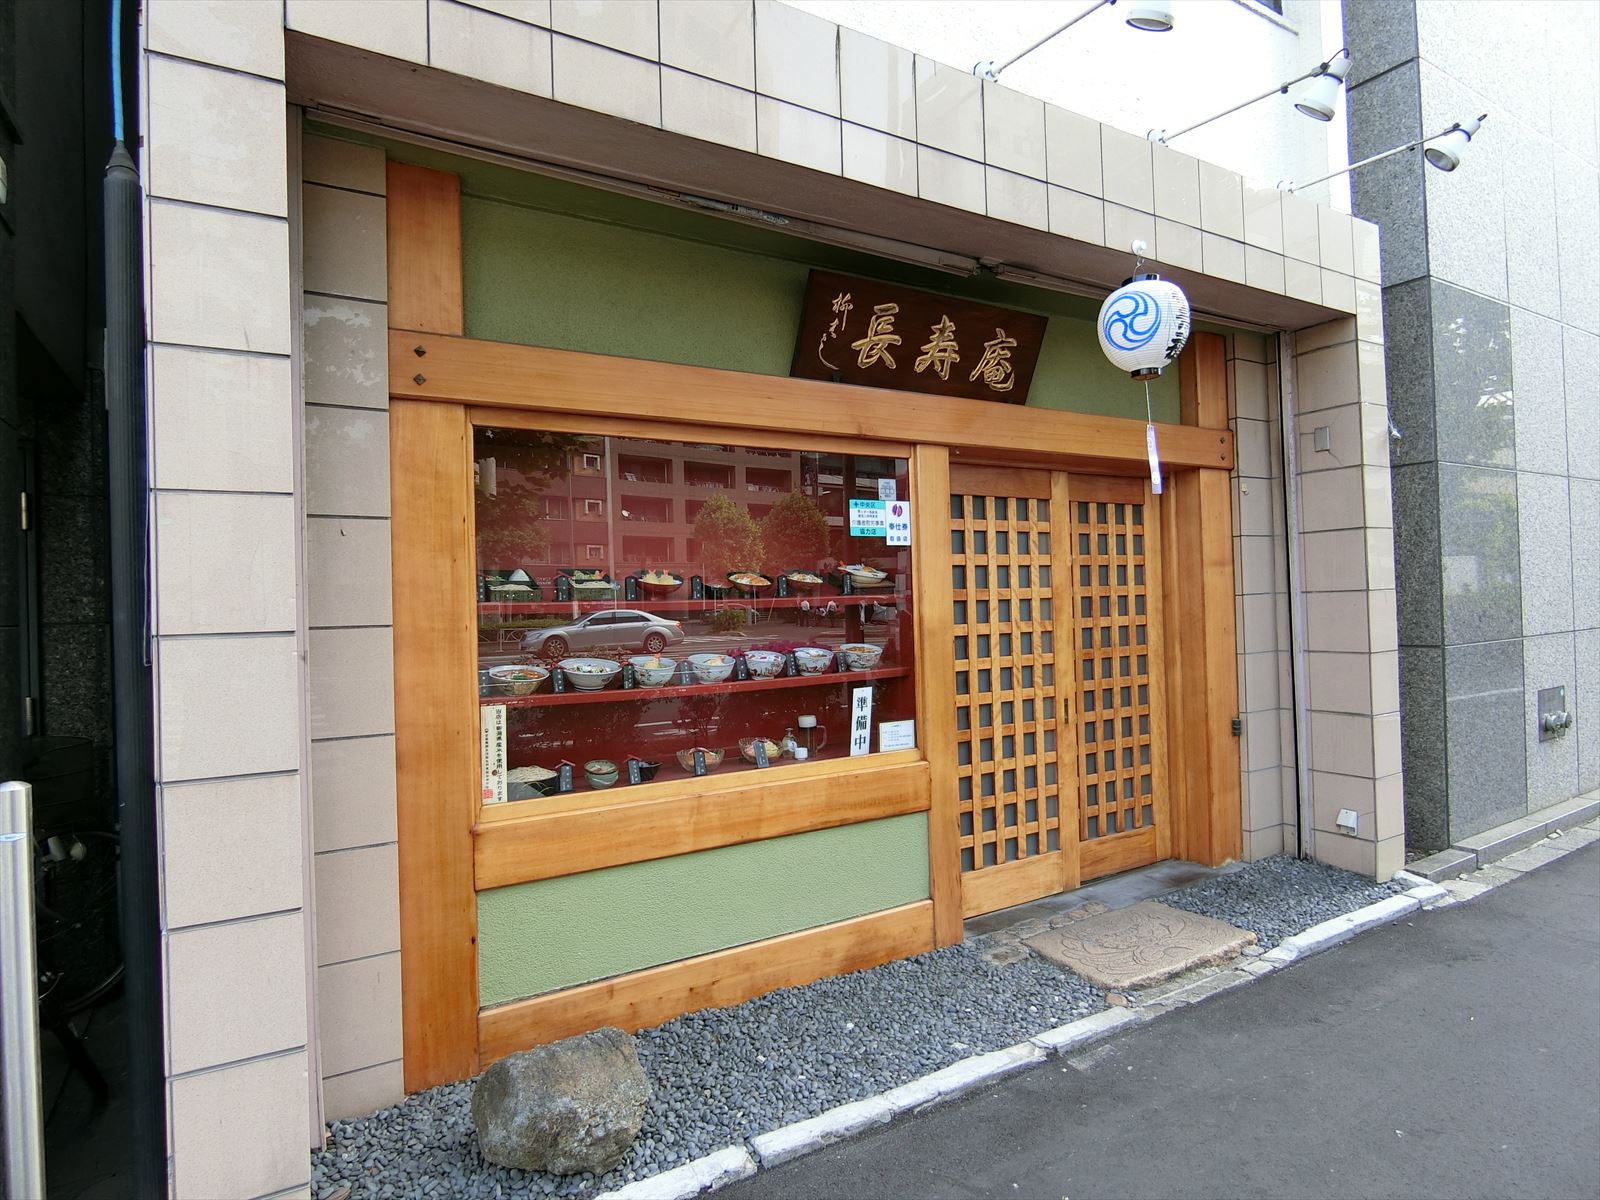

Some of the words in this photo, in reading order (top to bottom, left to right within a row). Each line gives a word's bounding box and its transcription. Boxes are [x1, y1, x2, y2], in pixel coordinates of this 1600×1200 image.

[851, 303, 1018, 392] 長寿庵
[854, 696, 868, 750] 準備中
